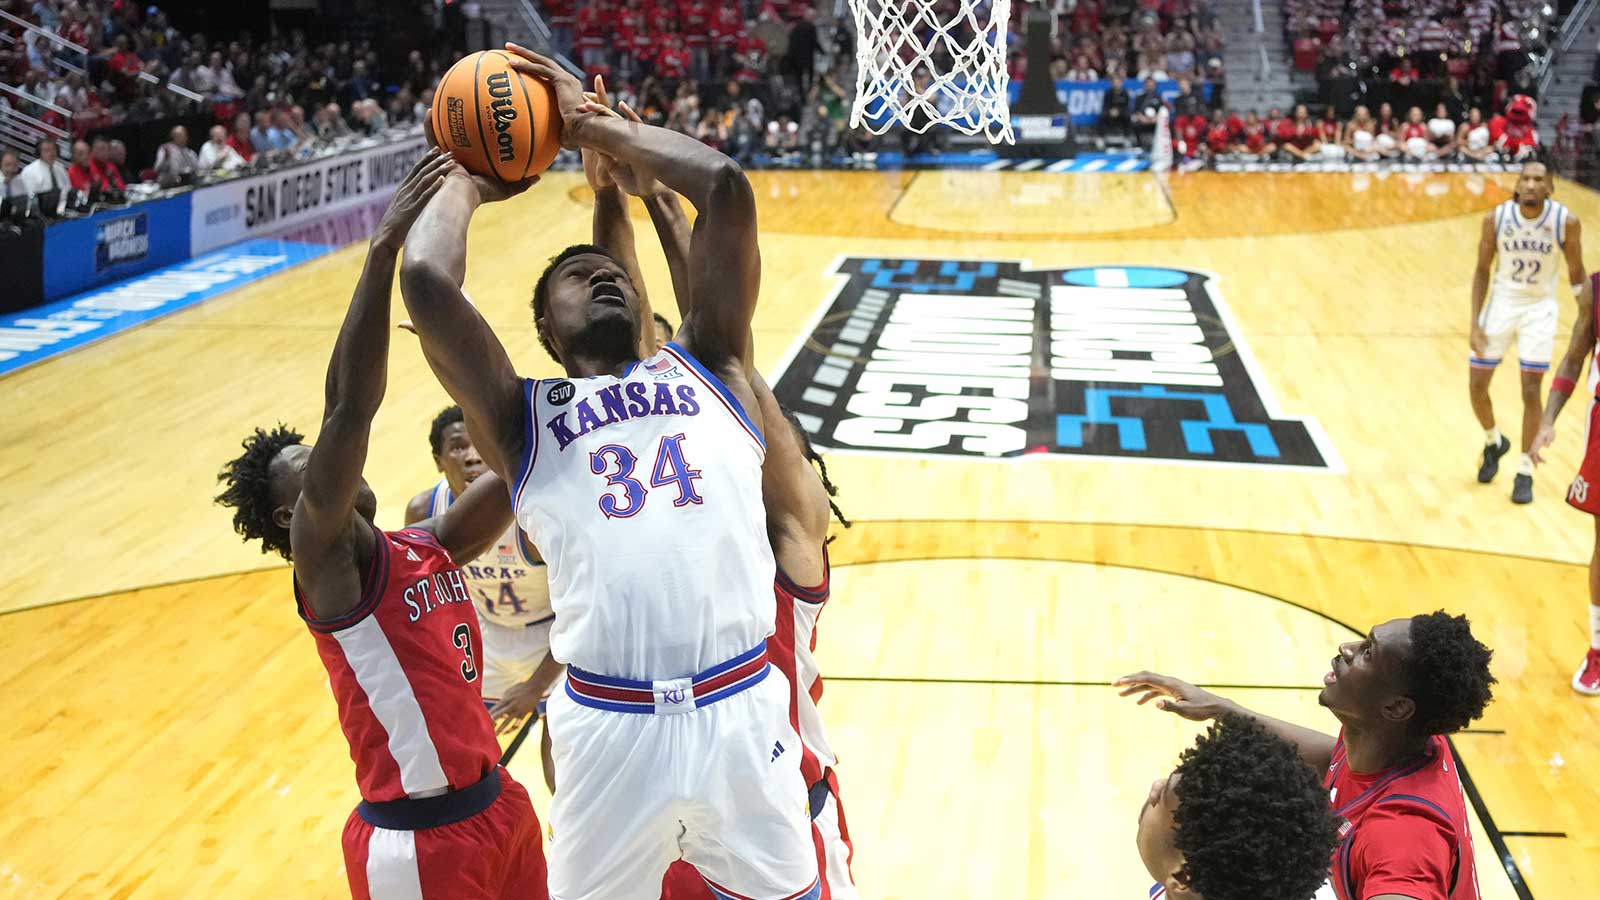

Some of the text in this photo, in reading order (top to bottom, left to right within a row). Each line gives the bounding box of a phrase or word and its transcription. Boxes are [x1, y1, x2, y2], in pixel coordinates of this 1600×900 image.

[486, 71, 517, 162] Wilson
[246, 182, 275, 228] SAN
[281, 170, 321, 217] DIEGO
[325, 159, 363, 203] STATE
[1504, 239, 1553, 254] KANSAS
[1511, 258, 1541, 284] 22
[1050, 285, 1224, 387] MARCH
[550, 384, 571, 402] SW
[832, 293, 1036, 456] MADNESS
[546, 382, 701, 452] KANSAS
[589, 433, 704, 520] 34
[462, 565, 527, 579] NSAS
[477, 581, 530, 616] 14
[452, 622, 478, 683] 3
[663, 688, 686, 704] KU
